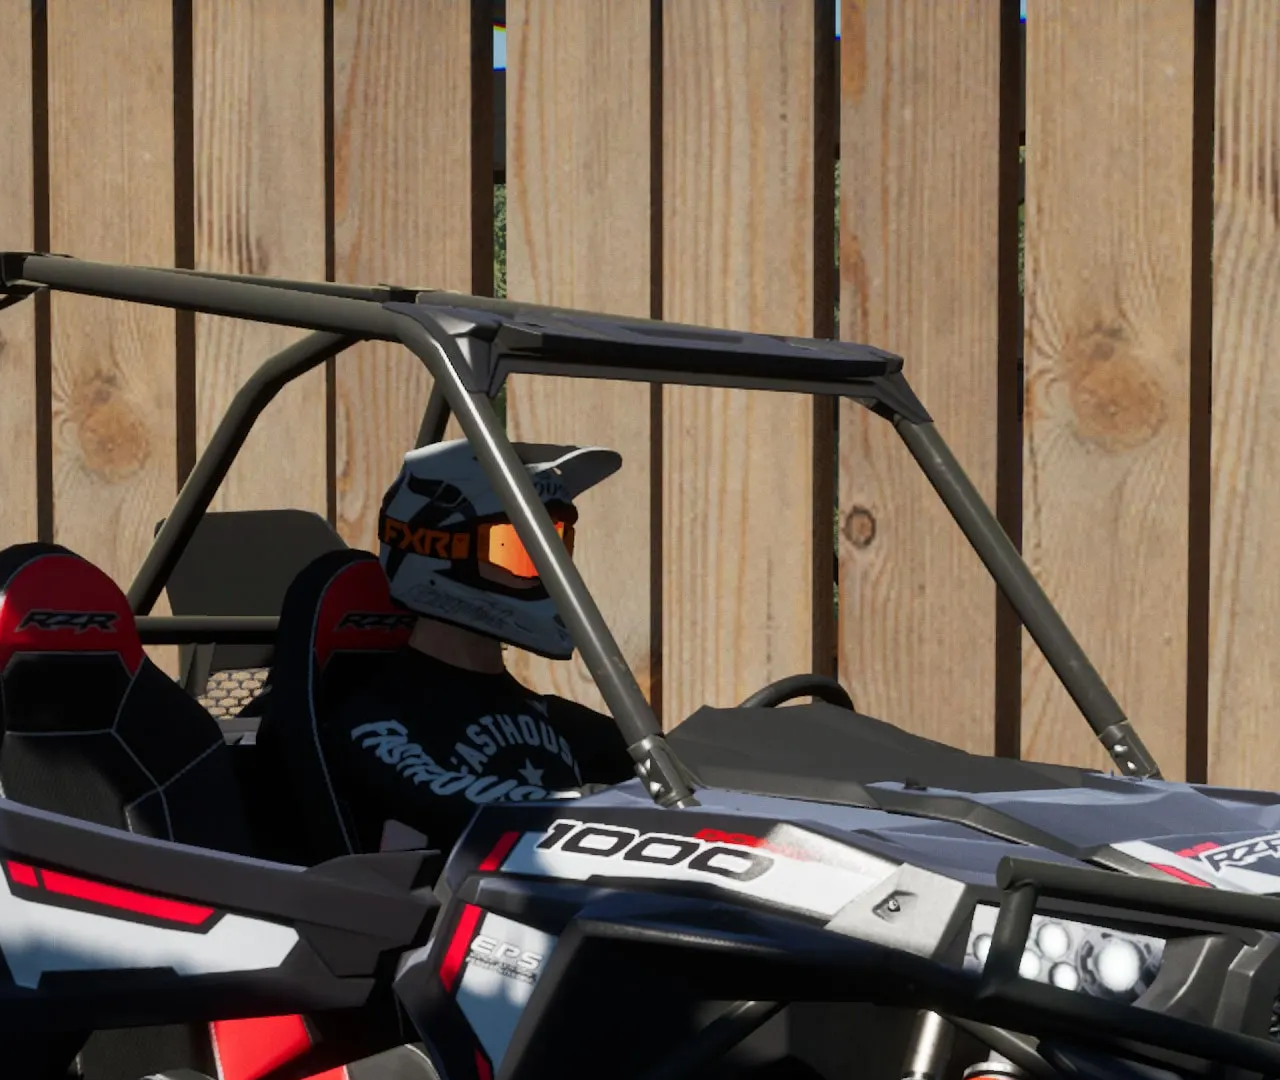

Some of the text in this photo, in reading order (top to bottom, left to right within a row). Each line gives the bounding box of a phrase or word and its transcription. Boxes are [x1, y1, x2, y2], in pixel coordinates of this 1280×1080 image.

[383, 517, 451, 560] FXR
[15, 609, 118, 634] RZR
[534, 820, 773, 882] 1000
[471, 934, 542, 971] EPS
